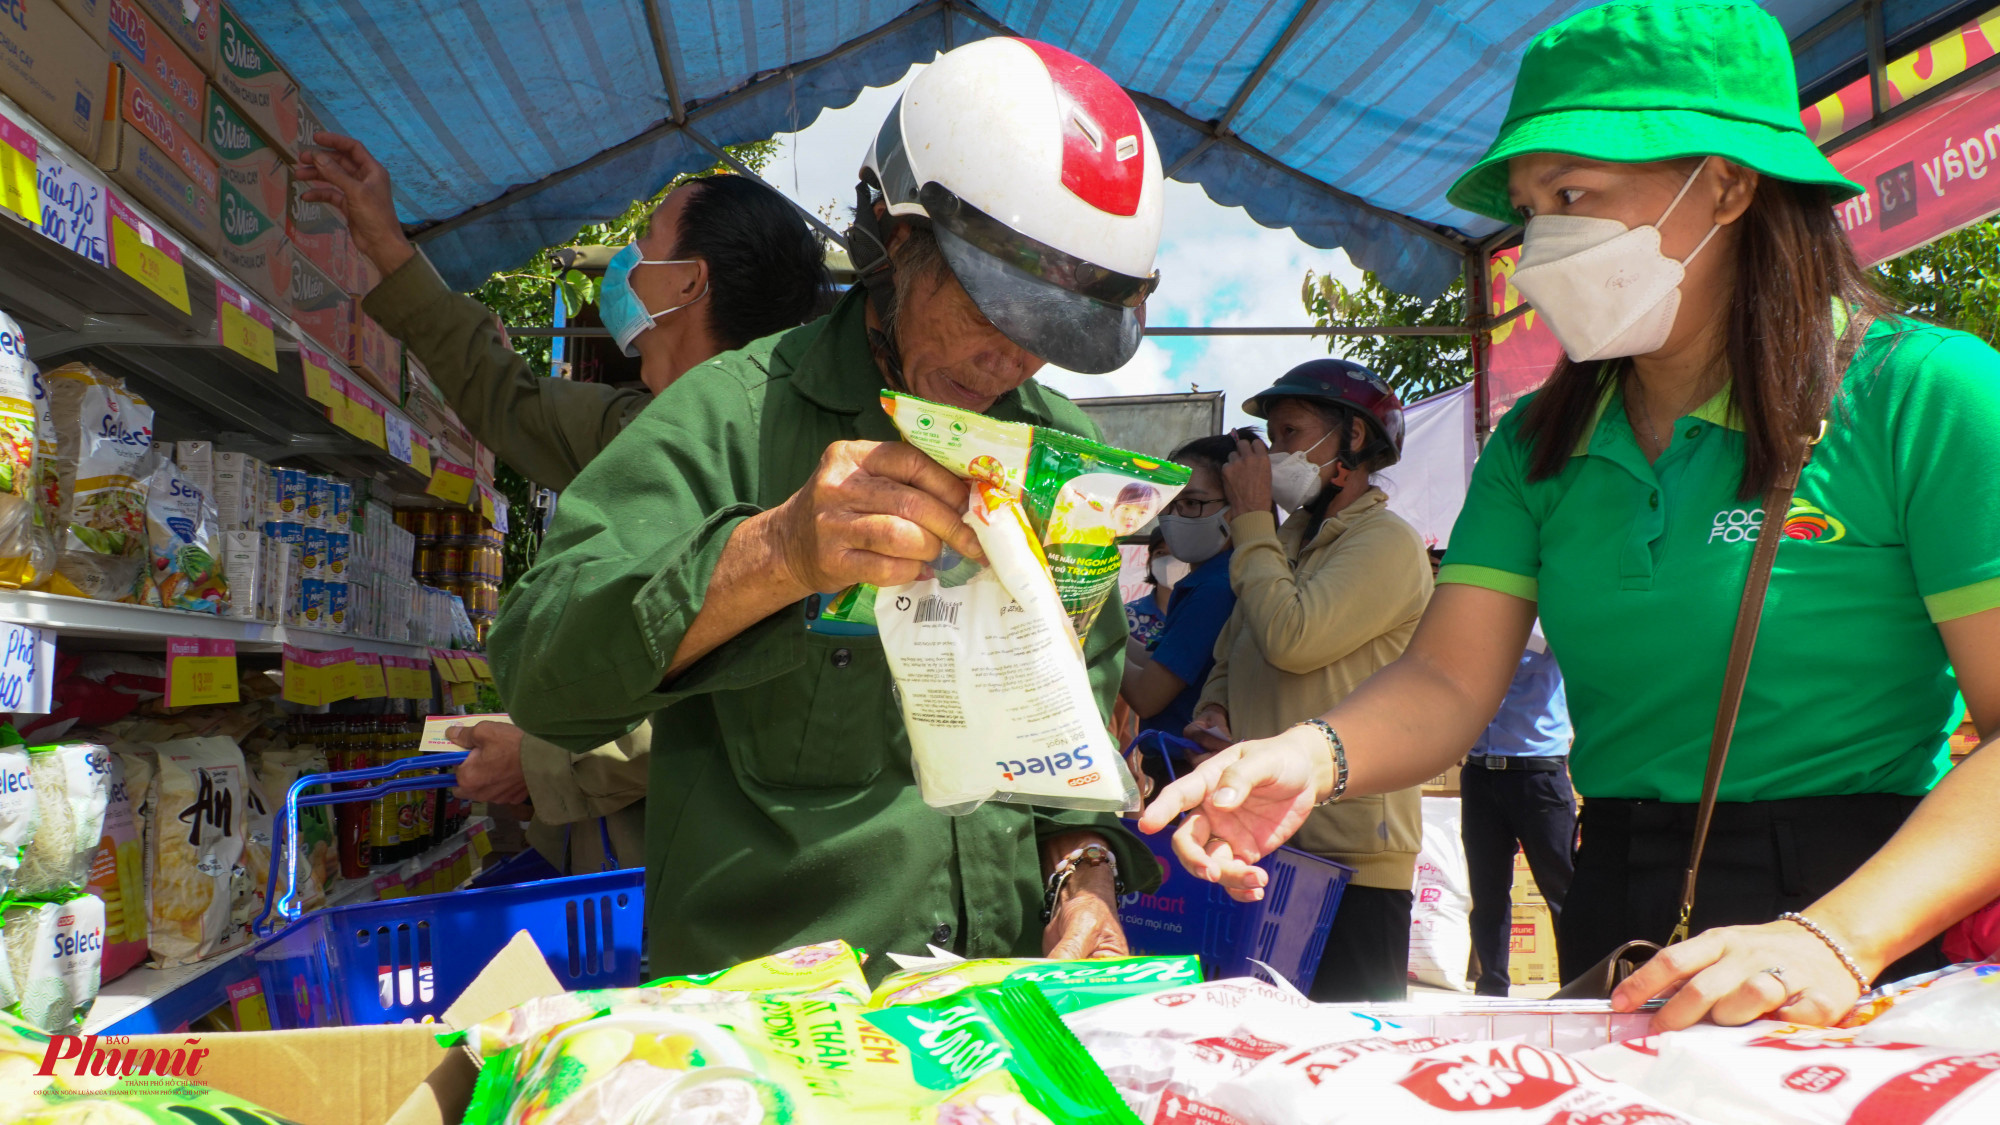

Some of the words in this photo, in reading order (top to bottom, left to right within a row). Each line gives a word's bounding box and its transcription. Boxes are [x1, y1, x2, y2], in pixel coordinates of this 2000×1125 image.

[1076, 557, 1107, 567] NGON
[996, 744, 1094, 778] Select
[0, 766, 34, 795] lect
[1069, 773, 1099, 786] COOP
[1118, 892, 1185, 915] pmart
[1511, 925, 1533, 936] ptune
[53, 927, 101, 959] Select
